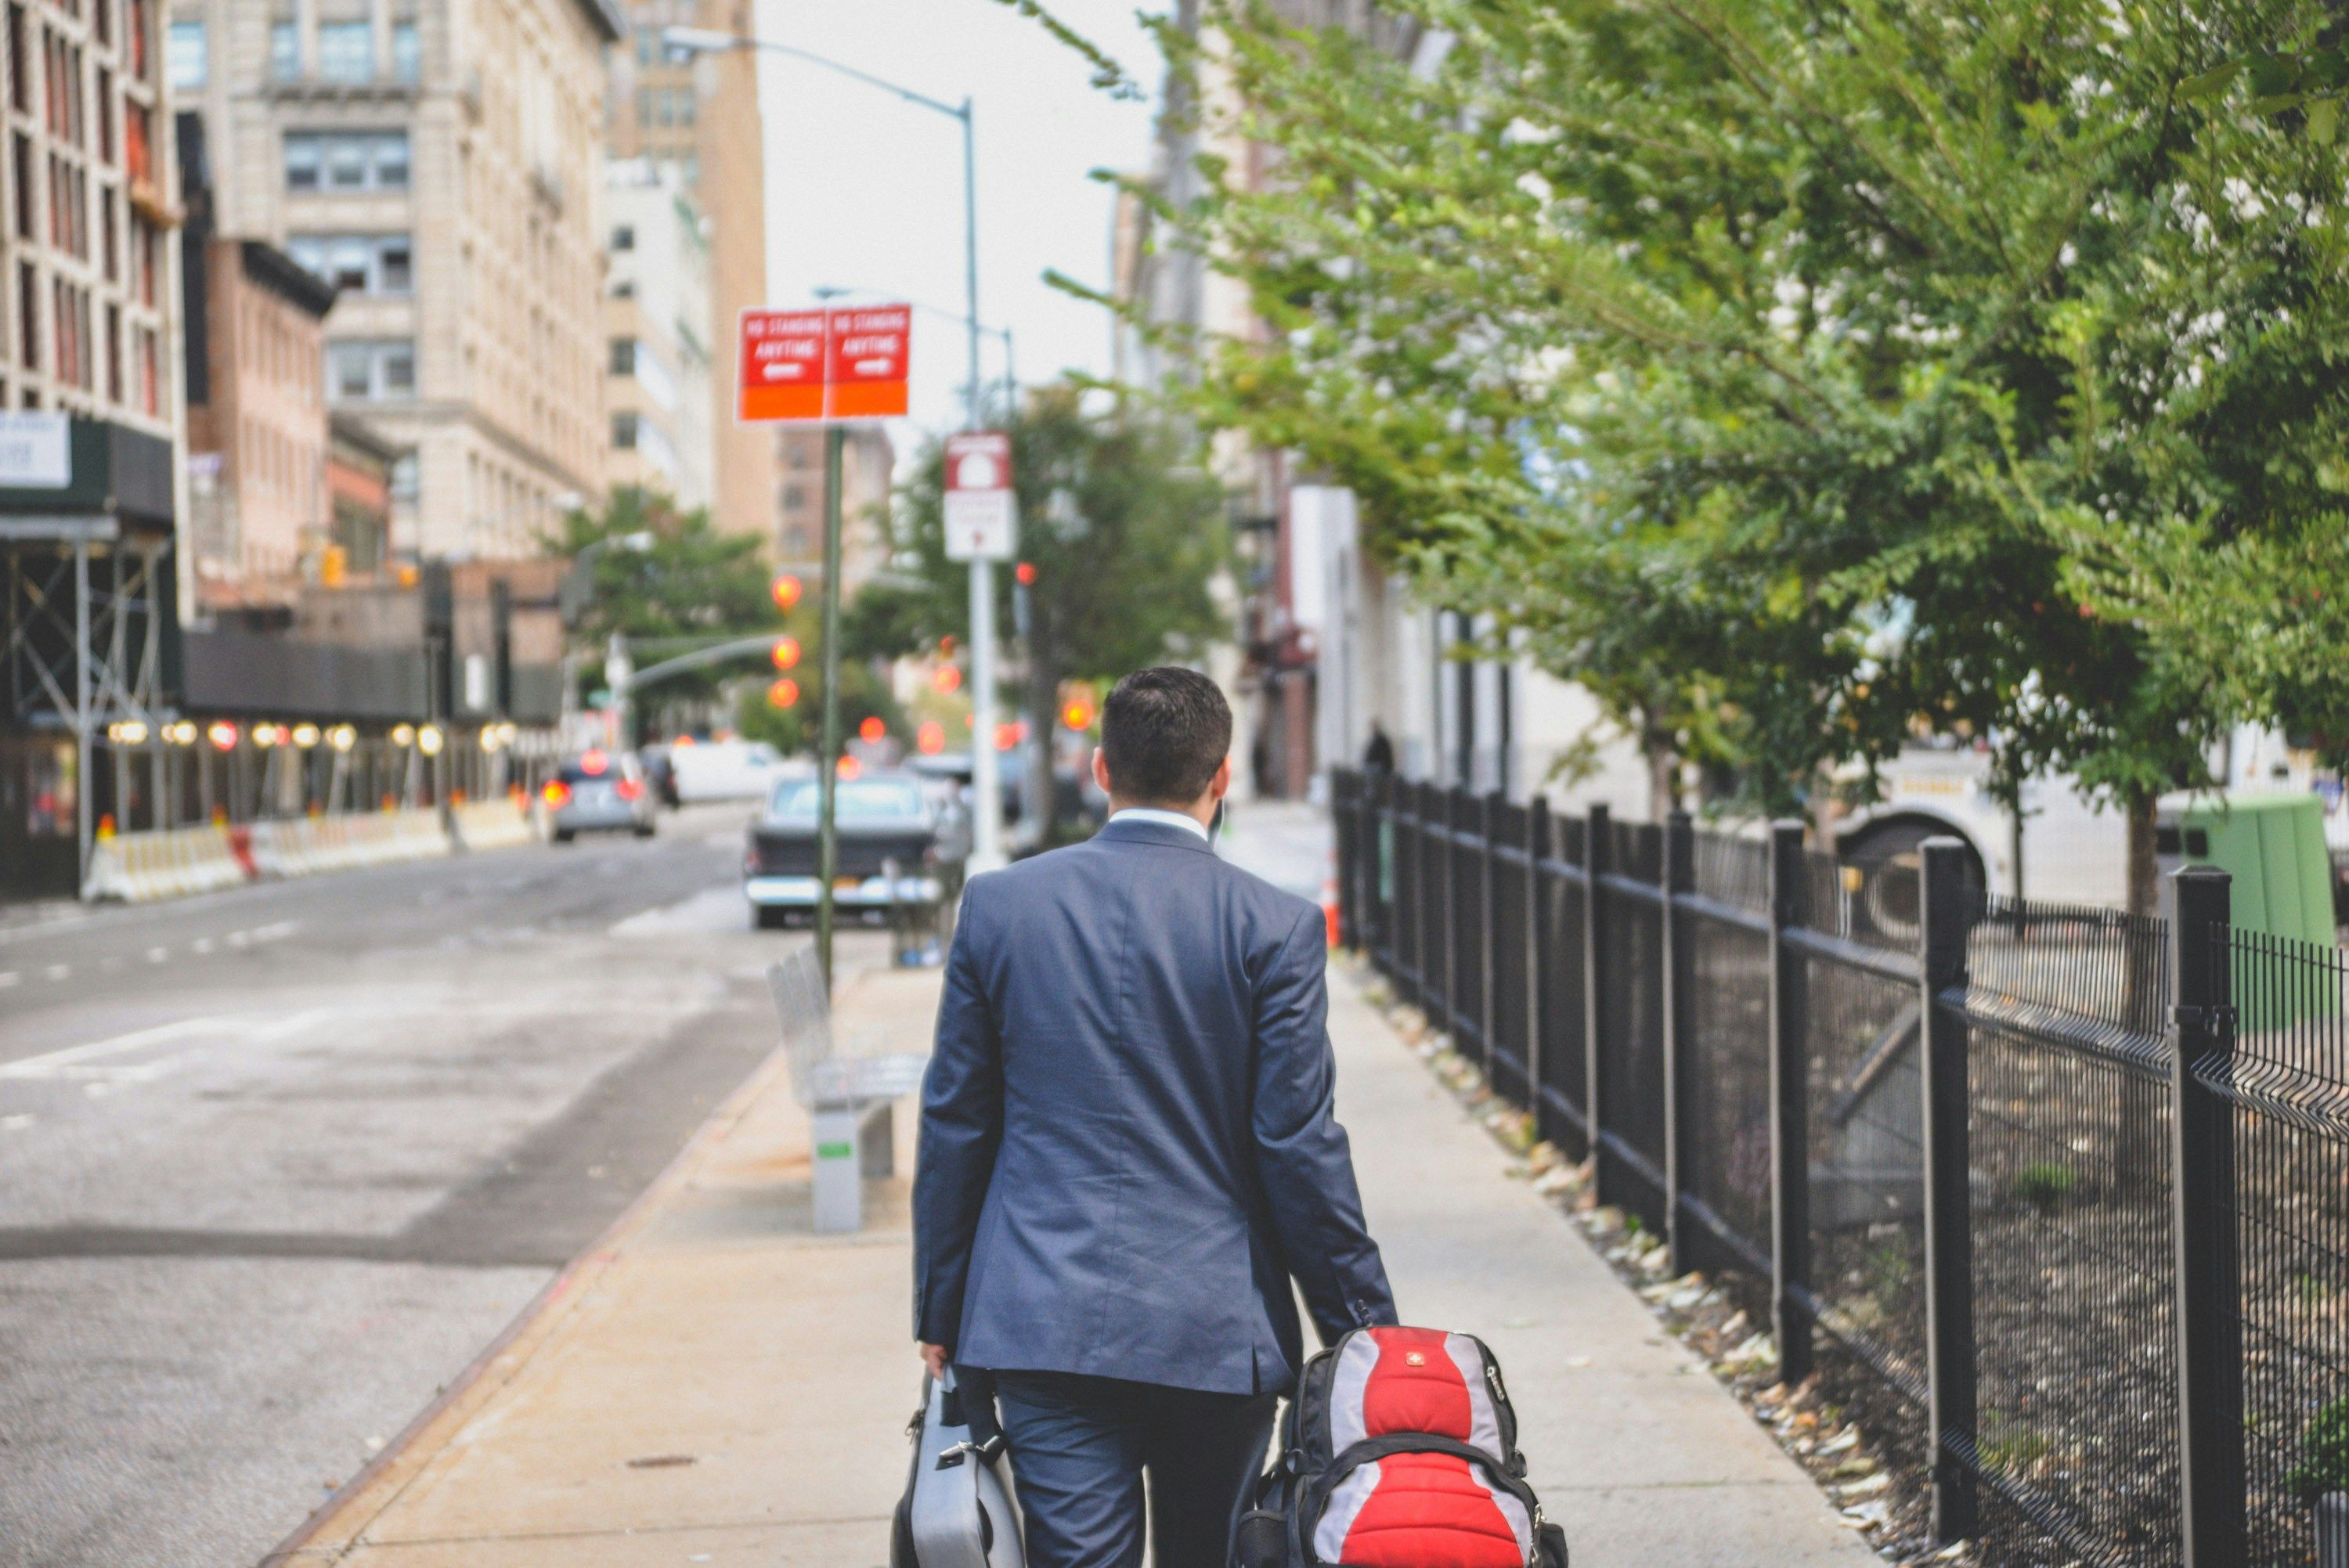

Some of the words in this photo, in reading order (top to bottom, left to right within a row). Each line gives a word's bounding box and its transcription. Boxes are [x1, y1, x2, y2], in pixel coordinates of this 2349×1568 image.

[746, 318, 765, 336] NO
[768, 315, 824, 334] STANDING
[833, 314, 851, 332] NO
[853, 312, 906, 331] STANDING
[754, 339, 816, 359] ANYTIME
[841, 335, 898, 355] ANYTIME
